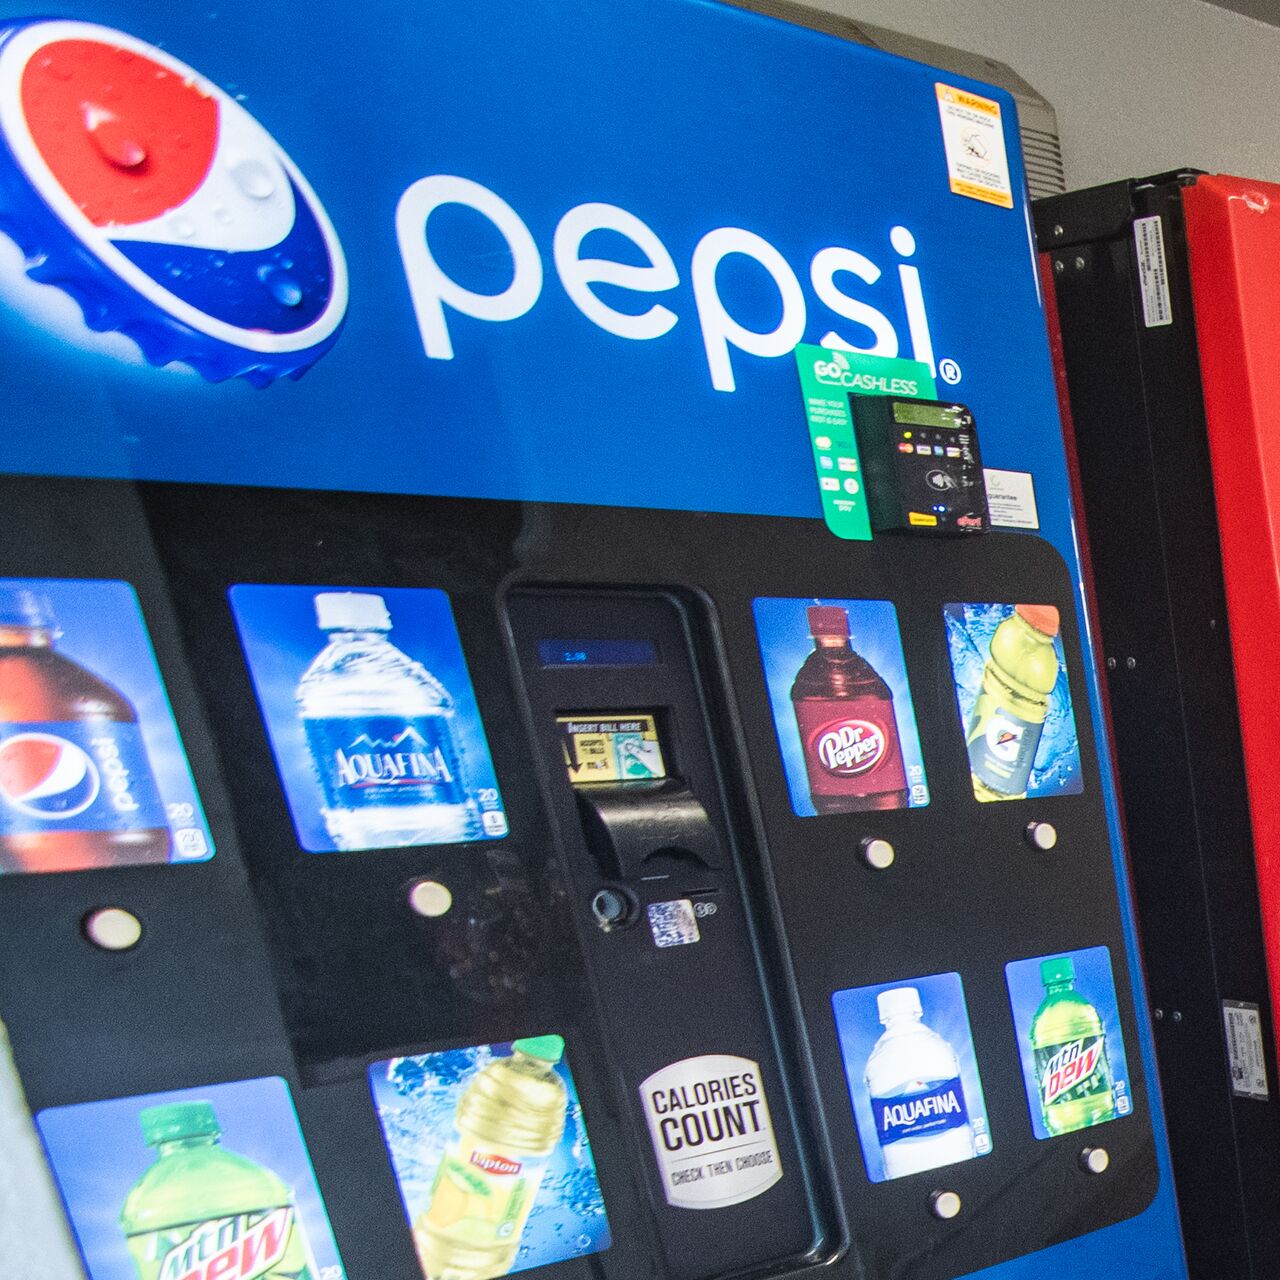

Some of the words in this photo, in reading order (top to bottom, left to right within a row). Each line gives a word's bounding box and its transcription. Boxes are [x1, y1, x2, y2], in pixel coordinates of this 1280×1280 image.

[395, 174, 938, 394] pepsi
[813, 358, 841, 377] GO
[840, 371, 919, 396] CASHLESS
[568, 722, 600, 734] INSERT
[600, 722, 618, 732] BILL
[619, 721, 642, 732] HERE
[838, 726, 864, 747] Dr
[986, 717, 1026, 763] G
[335, 746, 454, 789] AQUAFINA
[818, 732, 880, 769] Pepper
[90, 737, 139, 812] pepsi
[909, 764, 923, 777] 20
[165, 802, 194, 819] 20
[477, 788, 499, 802] 20
[652, 1073, 757, 1114] CALORIES
[1115, 1080, 1126, 1091] 20
[660, 1099, 762, 1151] COUNT
[883, 1089, 962, 1132] AQUAFINA
[972, 1116, 985, 1129] 20
[472, 1152, 519, 1175] Lipton
[671, 1166, 704, 1186] CHECK
[706, 1159, 734, 1178] THEN
[735, 1150, 774, 1171] CHOOSE
